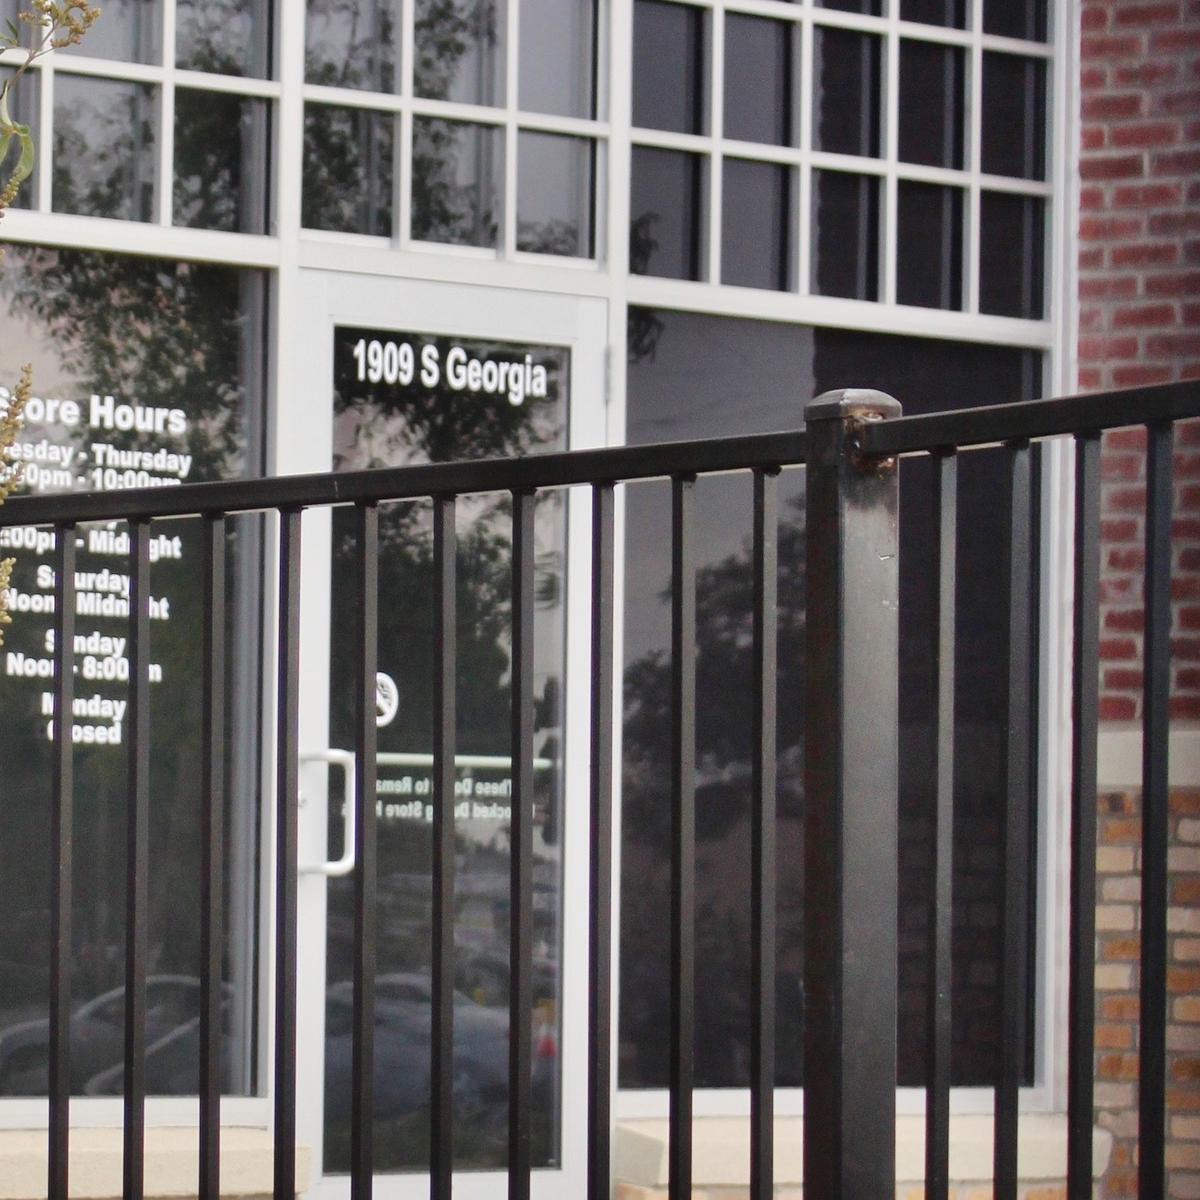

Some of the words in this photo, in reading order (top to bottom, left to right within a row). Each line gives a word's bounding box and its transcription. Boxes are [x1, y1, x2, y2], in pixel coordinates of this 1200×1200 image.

[353, 338, 415, 386] 1909
[420, 344, 441, 388] S
[446, 346, 548, 406] Georgia
[89, 394, 187, 434] Hours
[91, 443, 192, 477] Thursday
[88, 529, 183, 560] Midght
[36, 564, 130, 598] Surday
[76, 592, 170, 621] Midnht
[45, 628, 126, 658] Snday
[6, 652, 54, 678] Noo
[82, 655, 163, 683] 8:00m
[41, 691, 127, 721] Mnday
[46, 719, 122, 745] osed
